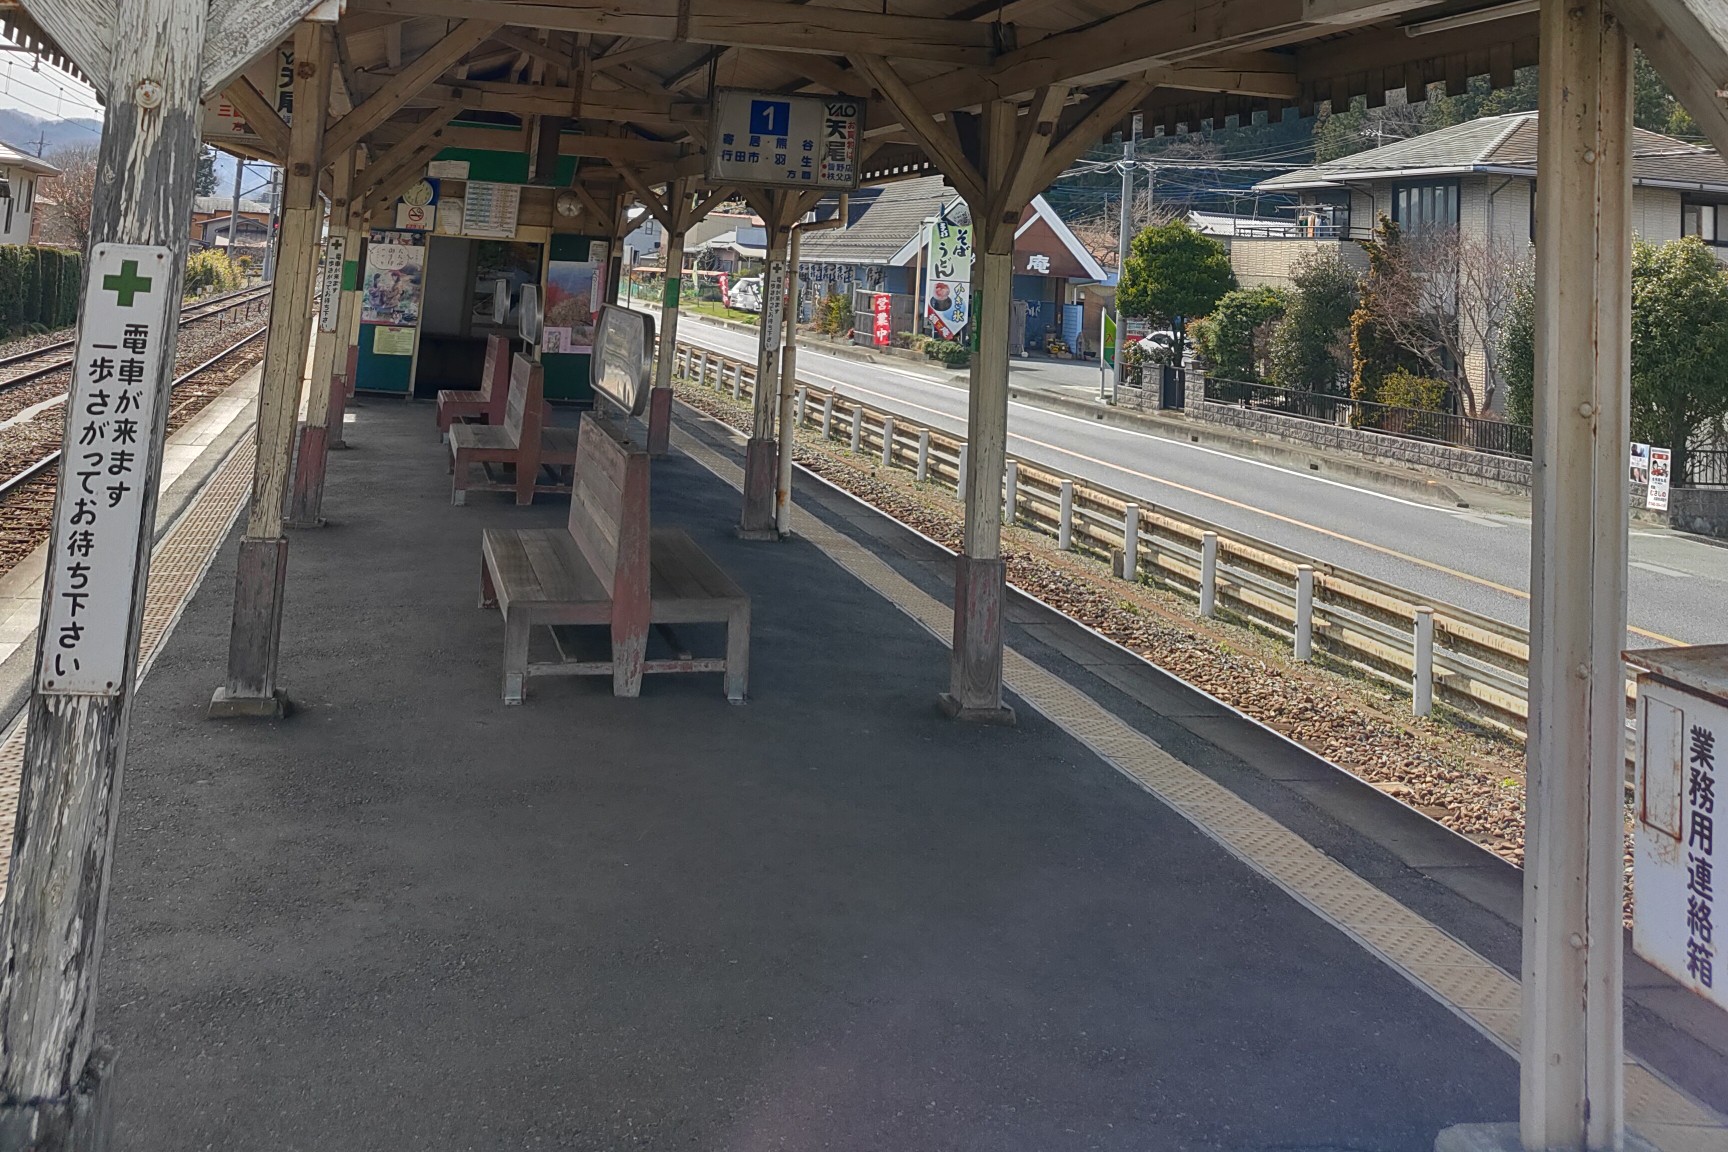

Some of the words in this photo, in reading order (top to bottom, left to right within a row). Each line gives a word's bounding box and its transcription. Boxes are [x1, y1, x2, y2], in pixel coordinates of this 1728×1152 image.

[762, 105, 775, 131] 1
[935, 242, 955, 278] うどん
[953, 228, 970, 257] そば
[876, 297, 890, 341] 営業中
[952, 283, 966, 323] かき氷
[105, 322, 149, 509] 電車が来ます
[54, 343, 118, 678] 一歩さがってお待ち下さい
[1686, 724, 1715, 989] 業務用連絡箱
